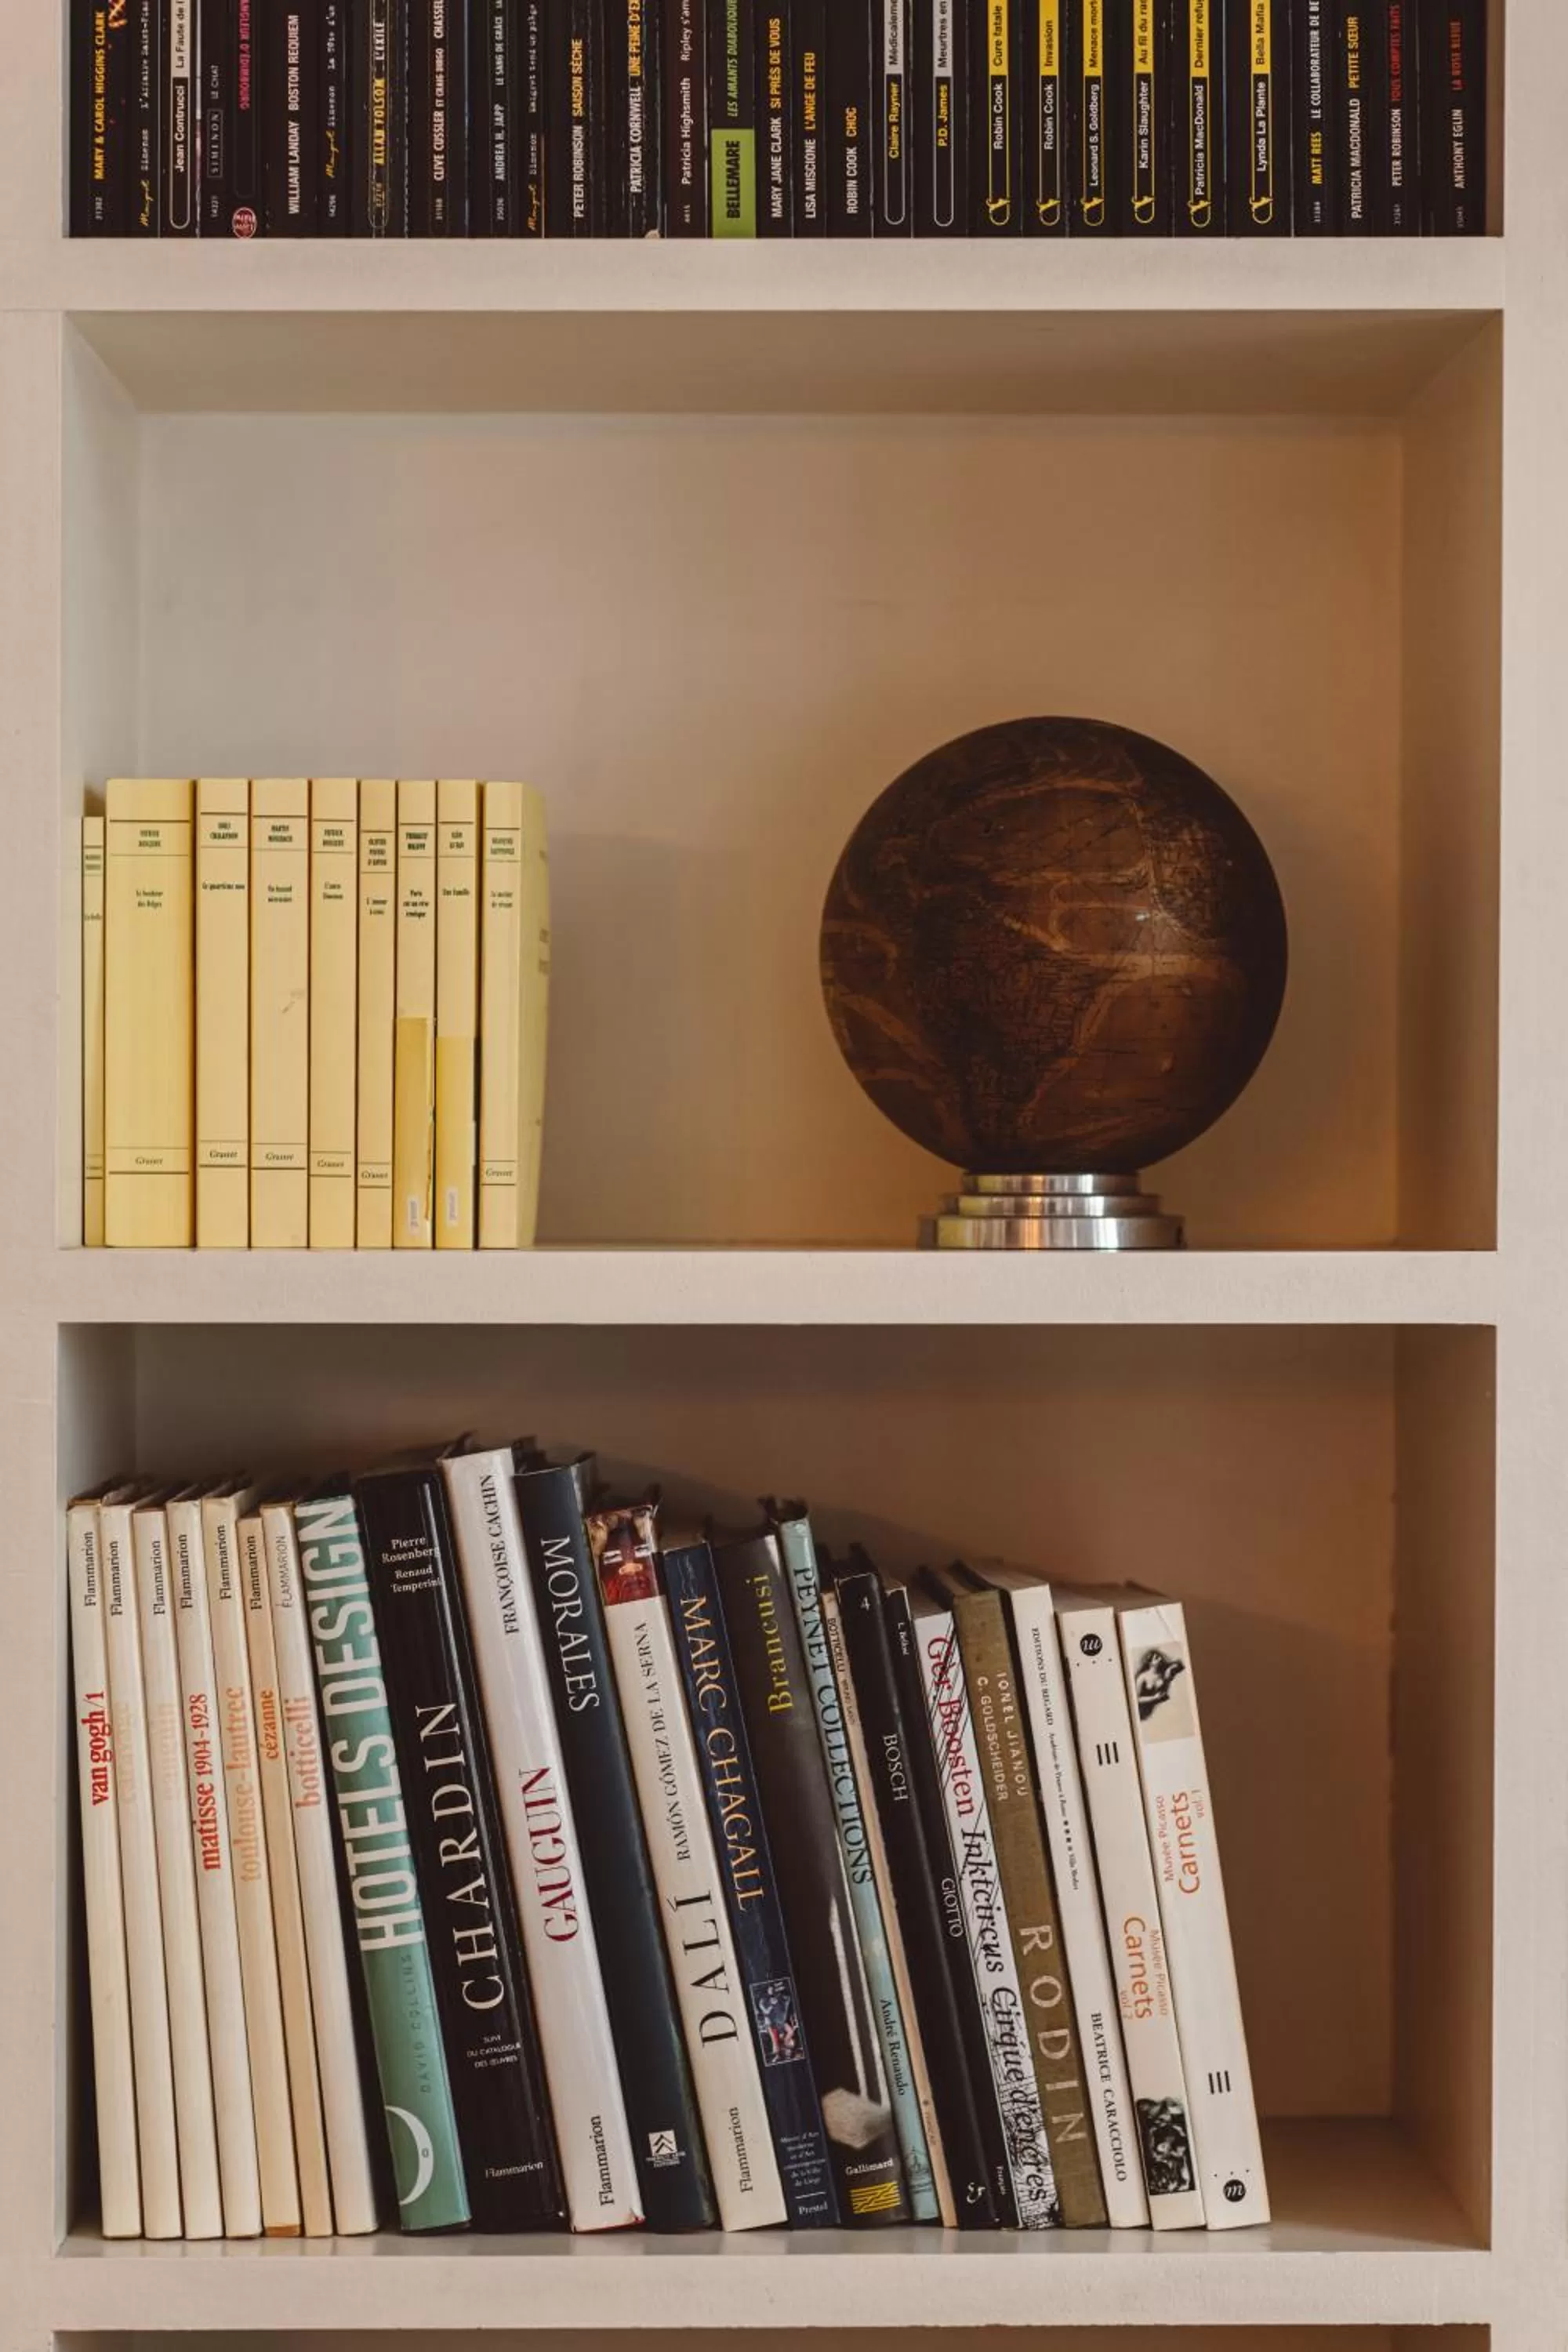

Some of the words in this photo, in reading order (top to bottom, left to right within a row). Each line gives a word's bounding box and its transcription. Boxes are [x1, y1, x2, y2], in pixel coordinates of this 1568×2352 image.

[96, 12, 104, 45] CLARK
[176, 7, 183, 20] de
[770, 18, 780, 47] VOUS
[1138, 18, 1148, 31] du
[1256, 2, 1265, 33] Mafia
[1310, 14, 1319, 26] DE
[289, 15, 299, 64] REQUIEM
[570, 38, 583, 73] SÈCHE
[681, 28, 691, 60] Ripley
[771, 50, 780, 64] DE
[938, 17, 948, 67] Meurtres
[993, 42, 1002, 66] Cure
[1044, 20, 1053, 66] Invasion
[1090, 27, 1098, 67] Menace
[1138, 35, 1148, 46] fil
[1139, 49, 1148, 64] Au
[1195, 27, 1203, 67] Dernier
[1256, 38, 1265, 64] Bella
[96, 49, 104, 93] HIGGINS
[176, 56, 183, 67] La
[728, 58, 738, 98] AMANTS
[768, 67, 781, 94] PRÈS
[804, 53, 815, 72] FEU
[1310, 29, 1321, 105] COLLABORATEUR
[1348, 52, 1359, 88] PETITE
[289, 67, 299, 110] BOSTON
[573, 76, 583, 116] SAISON
[804, 75, 815, 89] DE
[890, 82, 900, 122] Rayner
[994, 83, 1003, 113] Cook
[1044, 84, 1053, 113] Cook
[1257, 82, 1266, 117] Plante
[96, 96, 104, 132] CAROL
[176, 85, 184, 140] Contrucci
[495, 104, 504, 127] JAPP
[630, 85, 641, 143] CORNWELL
[681, 78, 693, 138] Highsmith
[728, 102, 738, 116] LES
[771, 98, 781, 108] SI
[804, 93, 815, 130] L'ANGE
[847, 107, 856, 136] CHOC
[938, 85, 948, 122] James
[1089, 84, 1100, 130] Goldberg
[1139, 81, 1151, 135] Slaughter
[1195, 85, 1204, 148] MacDonald
[1312, 108, 1321, 118] LE
[1452, 109, 1464, 136] EGLIN
[289, 121, 299, 163] LANDAY
[434, 111, 444, 151] CUSSLER
[771, 117, 782, 152] CLARK
[890, 126, 899, 158] Claire
[938, 125, 948, 147] P.D.
[994, 117, 1003, 150] Robin
[1044, 117, 1054, 150] Robin
[1090, 133, 1098, 143] S.
[1257, 121, 1266, 134] La
[1312, 131, 1322, 154] REES
[1350, 99, 1361, 167] MACDONALD
[1392, 108, 1402, 156] ROBINSON
[95, 148, 104, 179] MARY
[176, 144, 184, 172] Jean
[434, 154, 444, 181] CLIVE
[495, 143, 504, 180] ANDREA
[574, 125, 584, 180] ROBINSON
[630, 146, 642, 192] PATRICIA
[682, 142, 691, 184] Patricia
[771, 155, 782, 183] JANE
[806, 139, 815, 191] MISCIONE
[847, 147, 857, 176] COOK
[1090, 146, 1098, 186] Leonard
[1140, 139, 1149, 169] Karin
[1258, 137, 1267, 171] Lynda
[1312, 157, 1323, 184] MATT
[1454, 141, 1465, 188] ANTHONY
[289, 166, 299, 214] WILLIAM
[726, 140, 740, 219] BELLEMARE
[1196, 152, 1204, 195] Patricia
[1392, 160, 1402, 186] PETER
[574, 184, 584, 217] PETER
[771, 187, 782, 217] MARY
[806, 194, 815, 219] LISA
[848, 180, 858, 214] ROBIN
[1352, 170, 1362, 219] PATRICIA
[480, 1473, 503, 1537] CACHIN
[216, 1525, 234, 1600] Flammarion
[382, 1547, 440, 1564] Rosenberg
[391, 1537, 426, 1550] Pierre
[83, 1531, 97, 1606] Flammarion
[108, 1541, 124, 1616] Flammarion
[150, 1540, 165, 1616] Flammarion
[177, 1534, 194, 1609] Flammarion
[245, 1536, 263, 1610] Flammarion
[275, 1536, 292, 1608] FLAMMARION
[394, 1564, 433, 1579] Renaud
[490, 1540, 520, 1634] FRANÇOISE
[295, 1495, 388, 1715] DESIGN
[540, 1537, 600, 1711] MORALES
[633, 1622, 655, 1677] SERNA
[746, 1574, 794, 1714] Brancusi
[827, 1617, 845, 1672] BOTTICELLI
[646, 1682, 660, 1704] LA
[978, 1676, 989, 1697] C.
[82, 1711, 112, 1763] gogh
[190, 1694, 212, 1776] 1904-1928
[259, 1690, 279, 1760] cézanne
[651, 1711, 665, 1733] DE
[793, 1566, 829, 1674] PEYNET
[816, 1685, 874, 1886] COLLECTIONS
[996, 1672, 1014, 1723] IONEL
[1006, 1731, 1029, 1796] JIANOU
[285, 1696, 321, 1807] botticelli
[655, 1739, 677, 1797] GÓMEZ
[678, 1595, 728, 1711] MARC
[706, 1726, 766, 1913] CHAGALL
[883, 1734, 908, 1802] BOSCH
[980, 1697, 1008, 1801] GOLDSCHEIDER
[91, 1766, 110, 1806] van
[225, 1686, 263, 1882] toulouse-lautrec
[194, 1782, 221, 1871] matisse
[667, 1802, 691, 1863] RAMÓN
[1156, 1795, 1167, 1838] Picasso
[331, 1734, 425, 1951] HOTELS
[415, 1701, 504, 2009] CHARDIN
[518, 1766, 579, 1943] GAUGUIN
[1163, 1842, 1174, 1882] Musée
[1171, 1791, 1200, 1893] Carnets
[941, 1878, 964, 1937] GIOTTO
[666, 1889, 739, 2049] DALÍ
[937, 1699, 976, 1817] Boosten
[960, 1828, 1007, 1973] Inktcircus
[991, 1987, 1027, 2082] Cirque
[1014, 2091, 1049, 2201] d'encres
[1123, 1917, 1154, 2019] Carnets
[401, 1953, 424, 2030] COLLINS
[1156, 1974, 1167, 2016] Picasso
[880, 1999, 897, 2038] André
[1019, 1925, 1087, 2143] RODIN
[414, 2042, 431, 2092] DAVID
[1091, 2013, 1112, 2083] BEATRICE
[1103, 2089, 1127, 2182] CARACCIOLO
[588, 2116, 614, 2205] Flammarion
[726, 2107, 754, 2193] Flammarion
[845, 2158, 894, 2176] Gallimard
